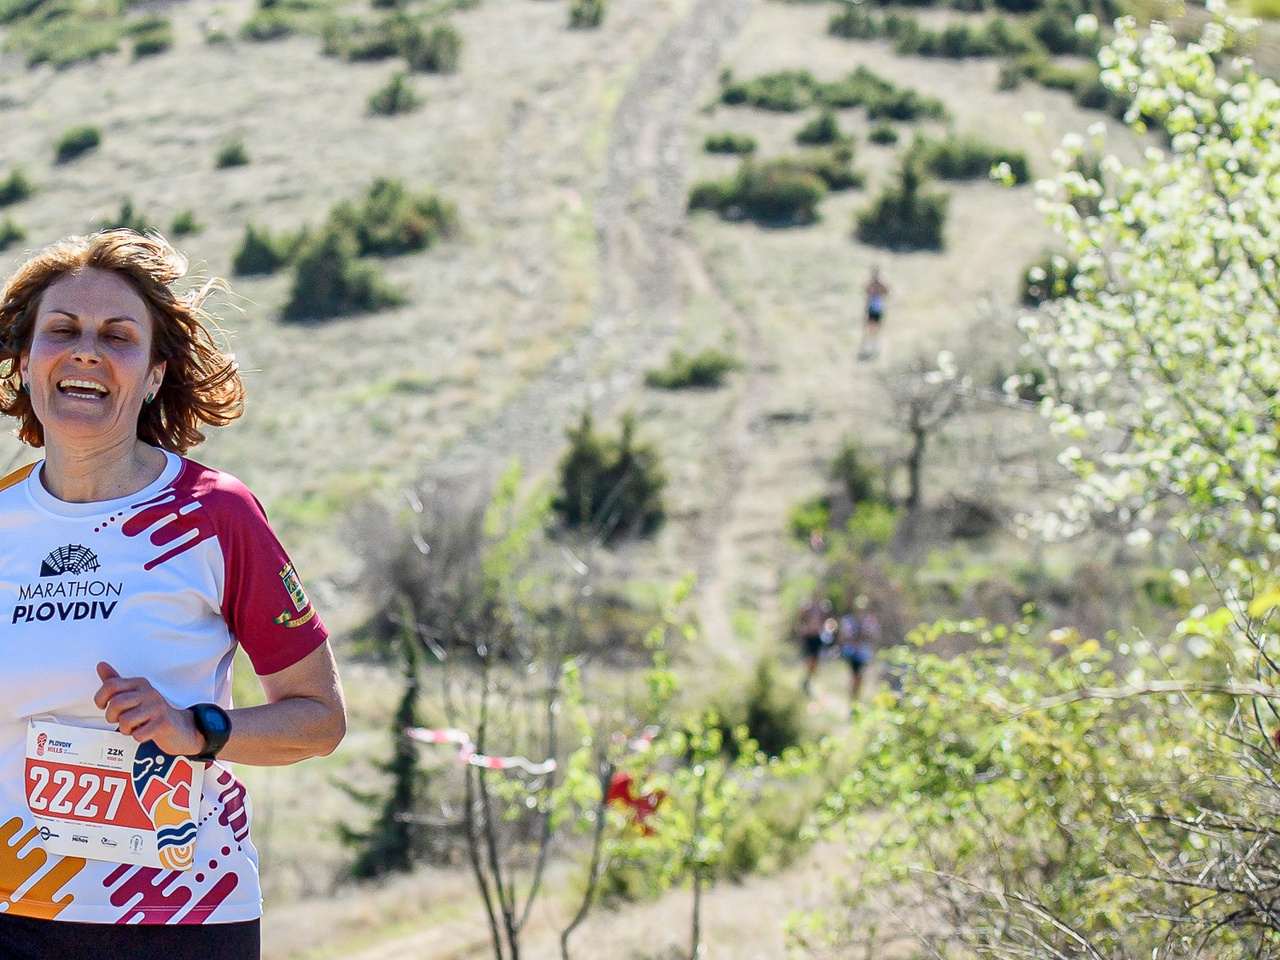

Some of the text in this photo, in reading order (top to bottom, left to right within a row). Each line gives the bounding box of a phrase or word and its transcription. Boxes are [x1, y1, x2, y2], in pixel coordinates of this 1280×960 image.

[18, 580, 123, 601] MARATHON
[11, 600, 118, 624] PLOVDIV
[107, 748, 124, 757] 22K
[29, 765, 128, 821] 2227
